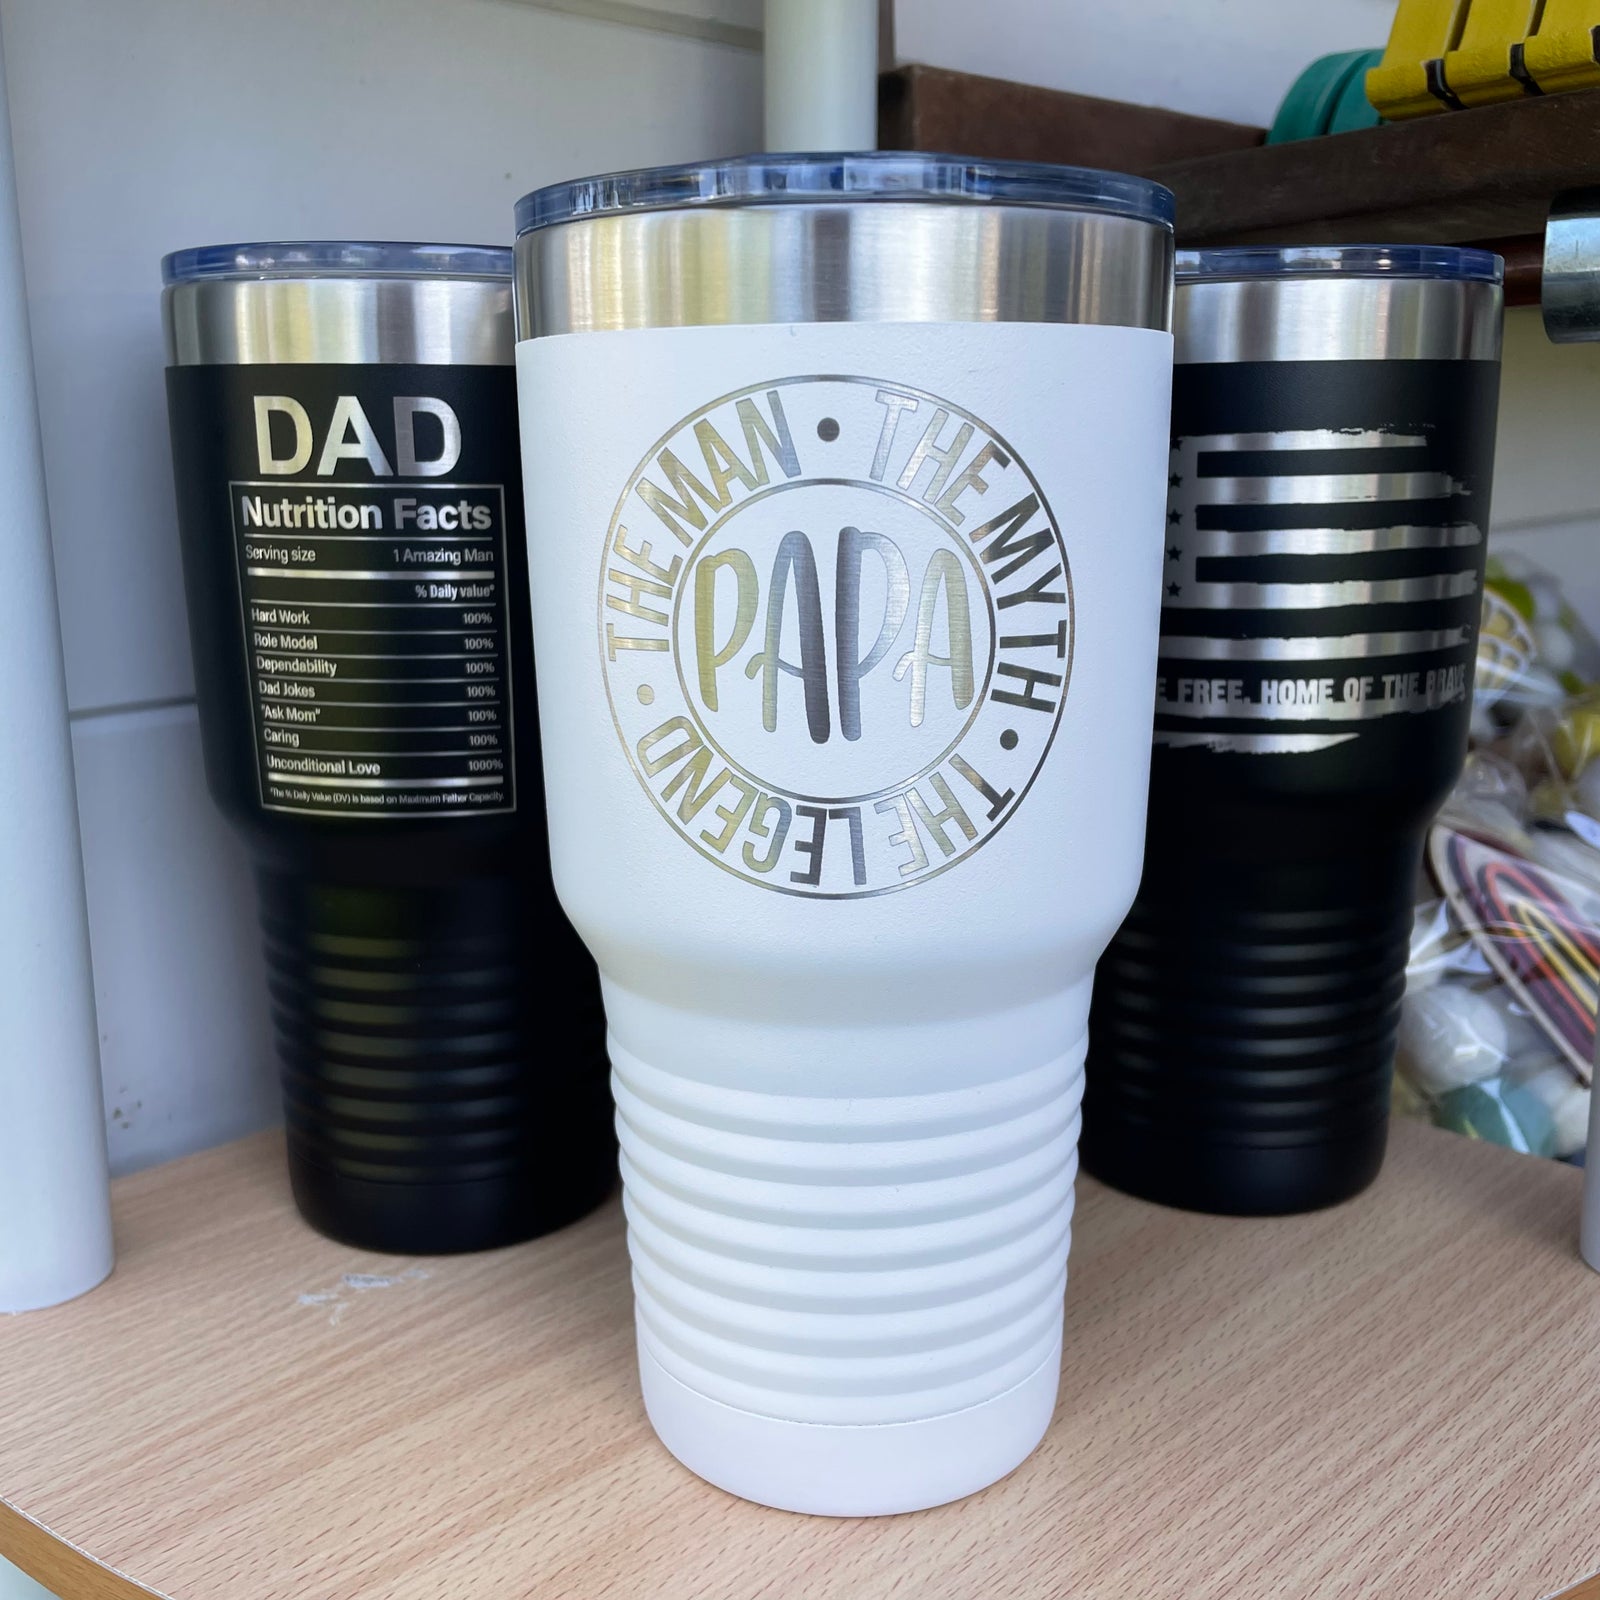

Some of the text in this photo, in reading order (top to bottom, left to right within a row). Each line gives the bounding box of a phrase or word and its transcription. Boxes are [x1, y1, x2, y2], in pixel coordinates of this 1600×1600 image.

[253, 395, 462, 477] DAD
[241, 495, 492, 531] Nutrition Facts
[605, 389, 802, 662] THE MAN
[245, 544, 316, 565] Serving size
[393, 548, 494, 566] 1 Amazing Man
[868, 389, 1067, 714] THE MYTH
[415, 584, 427, 598] %
[430, 584, 458, 601] Daily
[252, 608, 311, 625] Hard Work
[463, 613, 493, 624] 100%
[254, 633, 319, 650] Role Model
[464, 638, 494, 649] 100%
[693, 525, 975, 745] PAPA
[256, 656, 338, 678] Dependability
[465, 662, 495, 674] 100%
[258, 681, 316, 699] Dad Jokes
[466, 686, 496, 697] 100%
[1260, 678, 1334, 705] HOME
[1343, 676, 1374, 702] OF
[1381, 672, 1420, 699] THE
[468, 710, 497, 722] 100%
[263, 728, 300, 748] Caring
[469, 735, 498, 746] 100%
[266, 753, 381, 775] Unconditional Love
[468, 759, 504, 771] 1000%
[635, 714, 1016, 887] THE LEGEND
